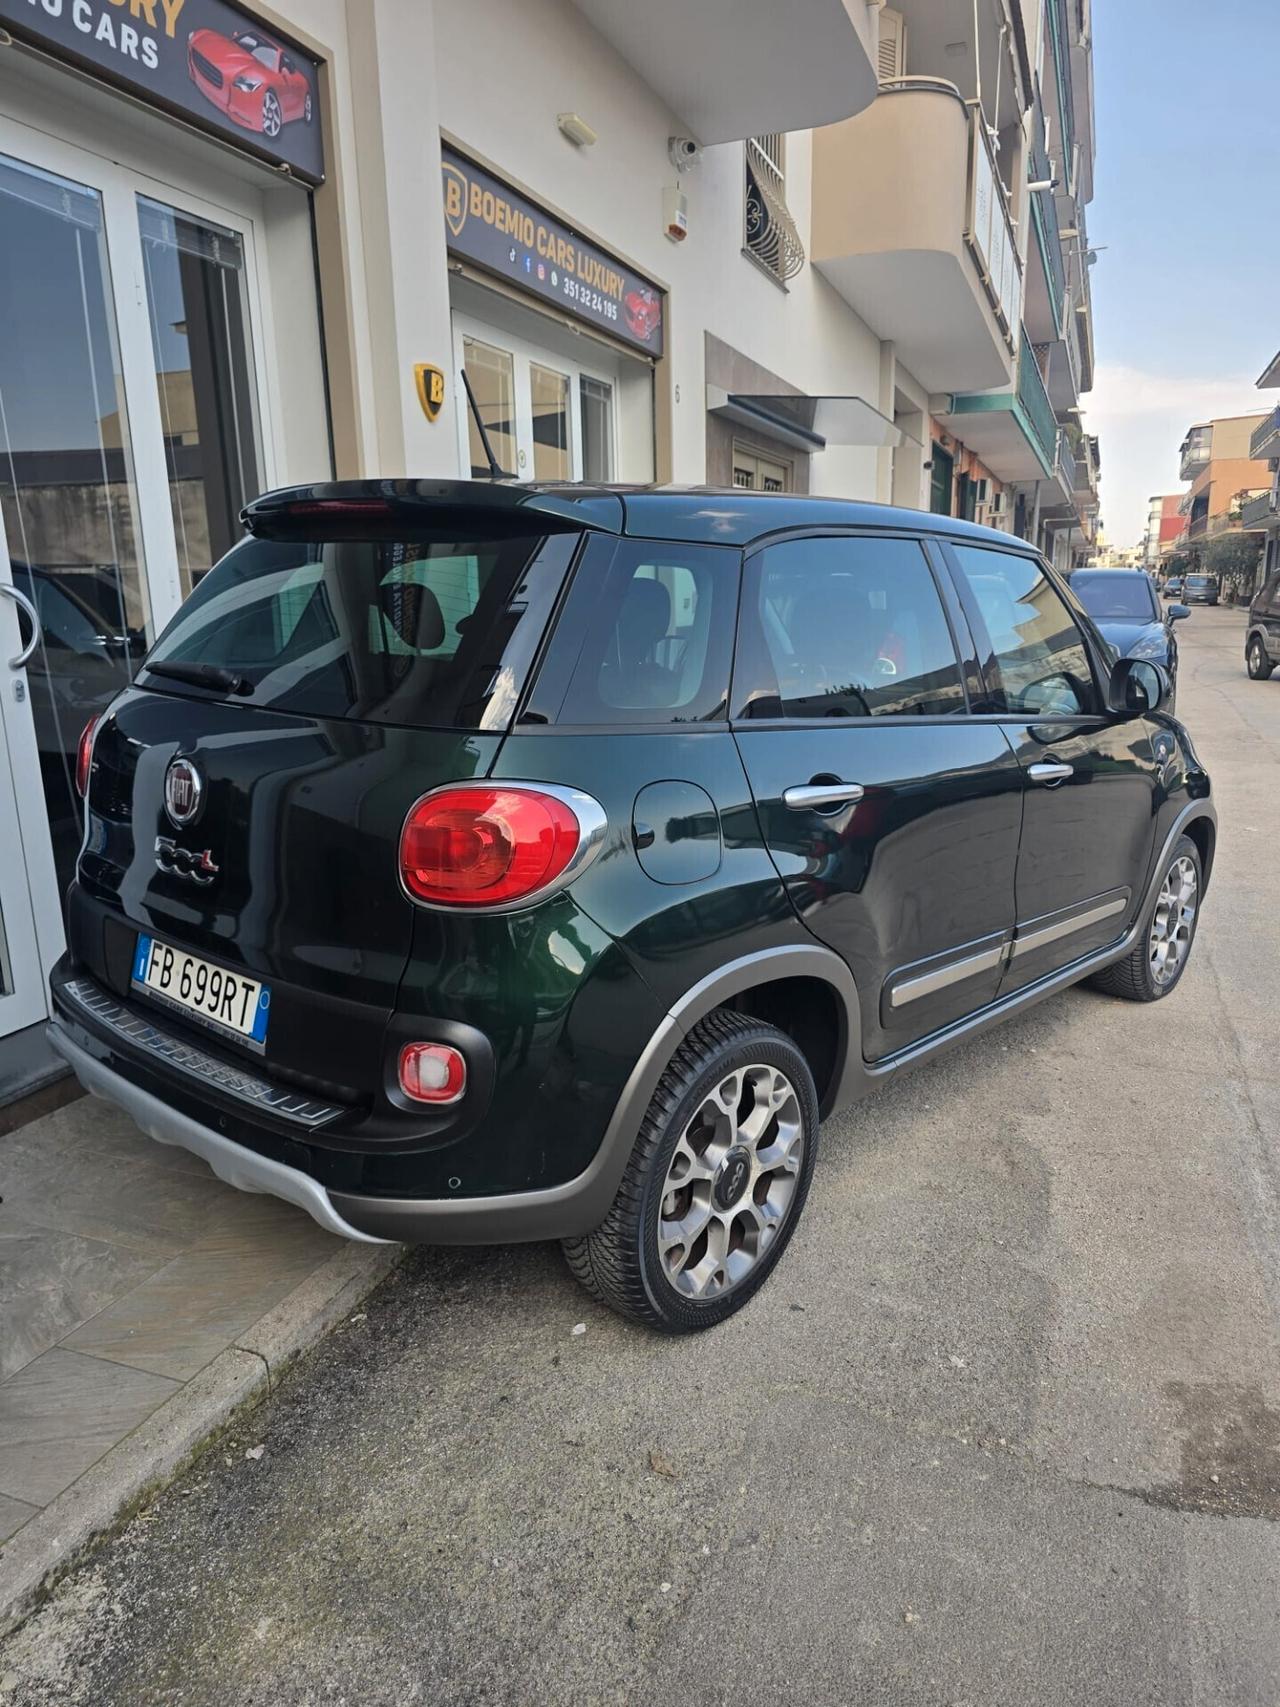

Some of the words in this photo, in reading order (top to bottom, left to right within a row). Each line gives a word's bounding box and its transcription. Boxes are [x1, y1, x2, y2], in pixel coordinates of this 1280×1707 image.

[72, 0, 160, 69] CARS
[447, 177, 461, 217] B
[470, 182, 534, 248] BOEMIO
[537, 225, 575, 273] CARS
[577, 250, 625, 301] LUXURY
[563, 277, 579, 300] 351
[580, 286, 591, 307] 32
[591, 293, 602, 313] 24
[603, 300, 617, 321] 195
[430, 372, 443, 405] B
[171, 777, 191, 806] FIAT
[148, 941, 174, 988] FB
[180, 958, 255, 1027] 699RT
